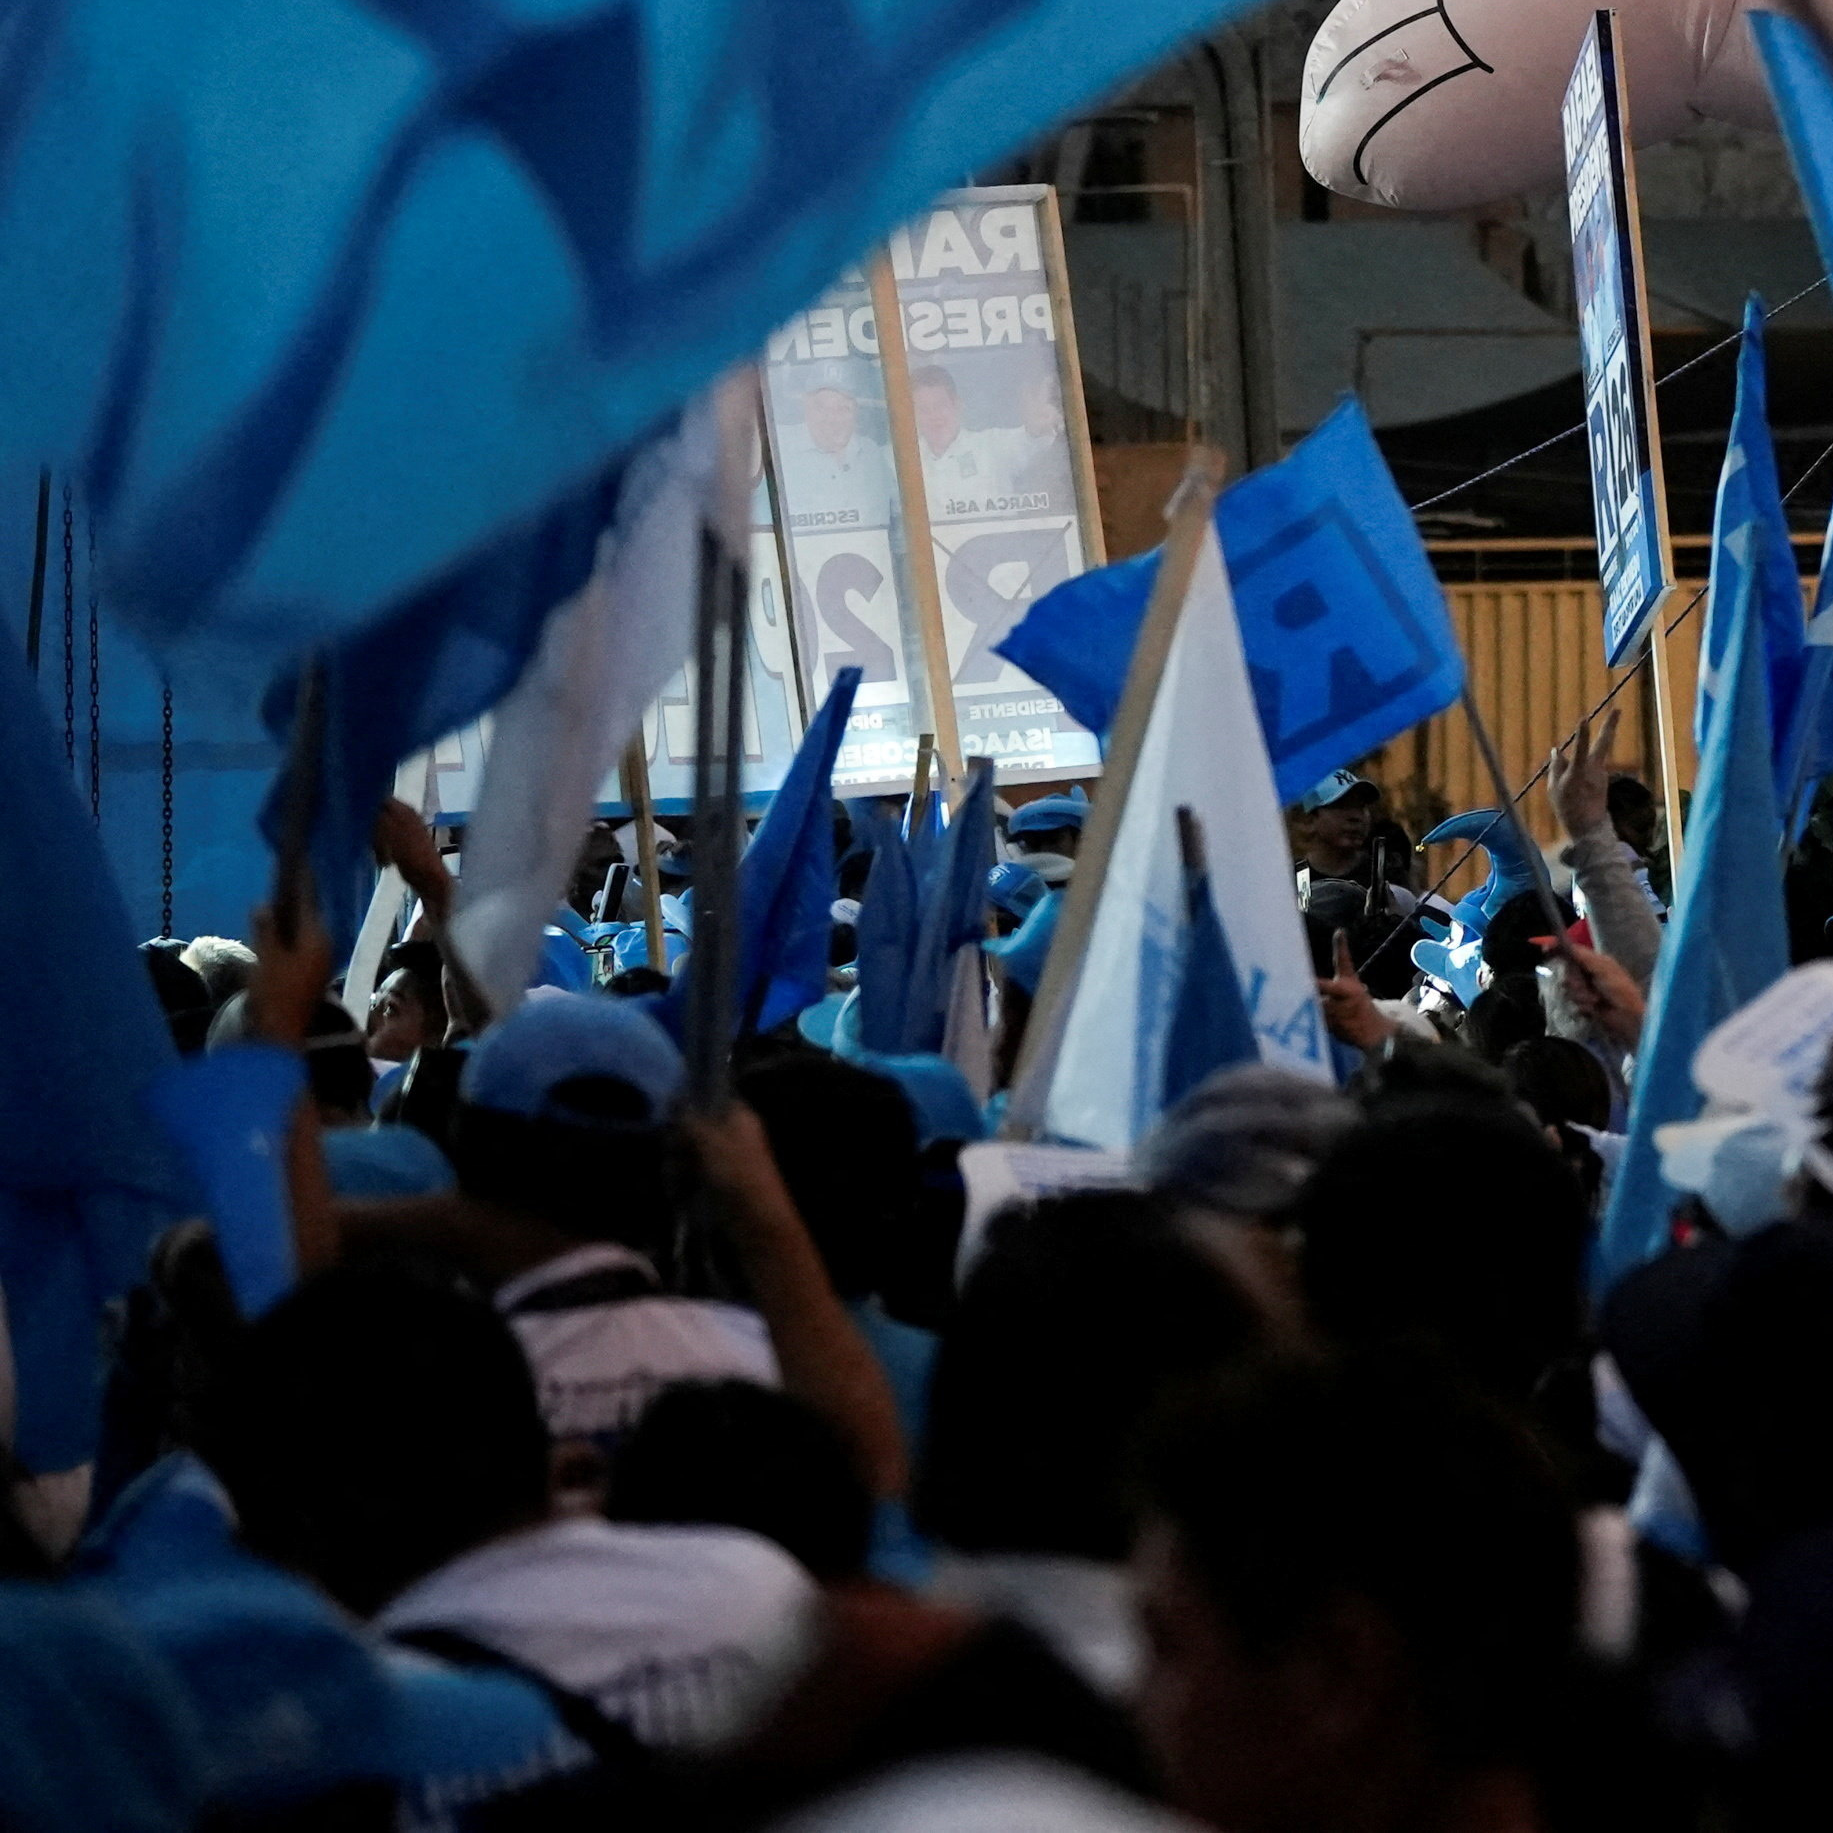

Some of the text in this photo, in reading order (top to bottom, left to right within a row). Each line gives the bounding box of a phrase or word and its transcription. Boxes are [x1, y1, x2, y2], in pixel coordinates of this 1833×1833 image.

[1563, 39, 1601, 171] RAFAEL
[1568, 117, 1610, 244] PRESIDENTE
[1590, 399, 1616, 552] R
[1609, 360, 1636, 509] 26
